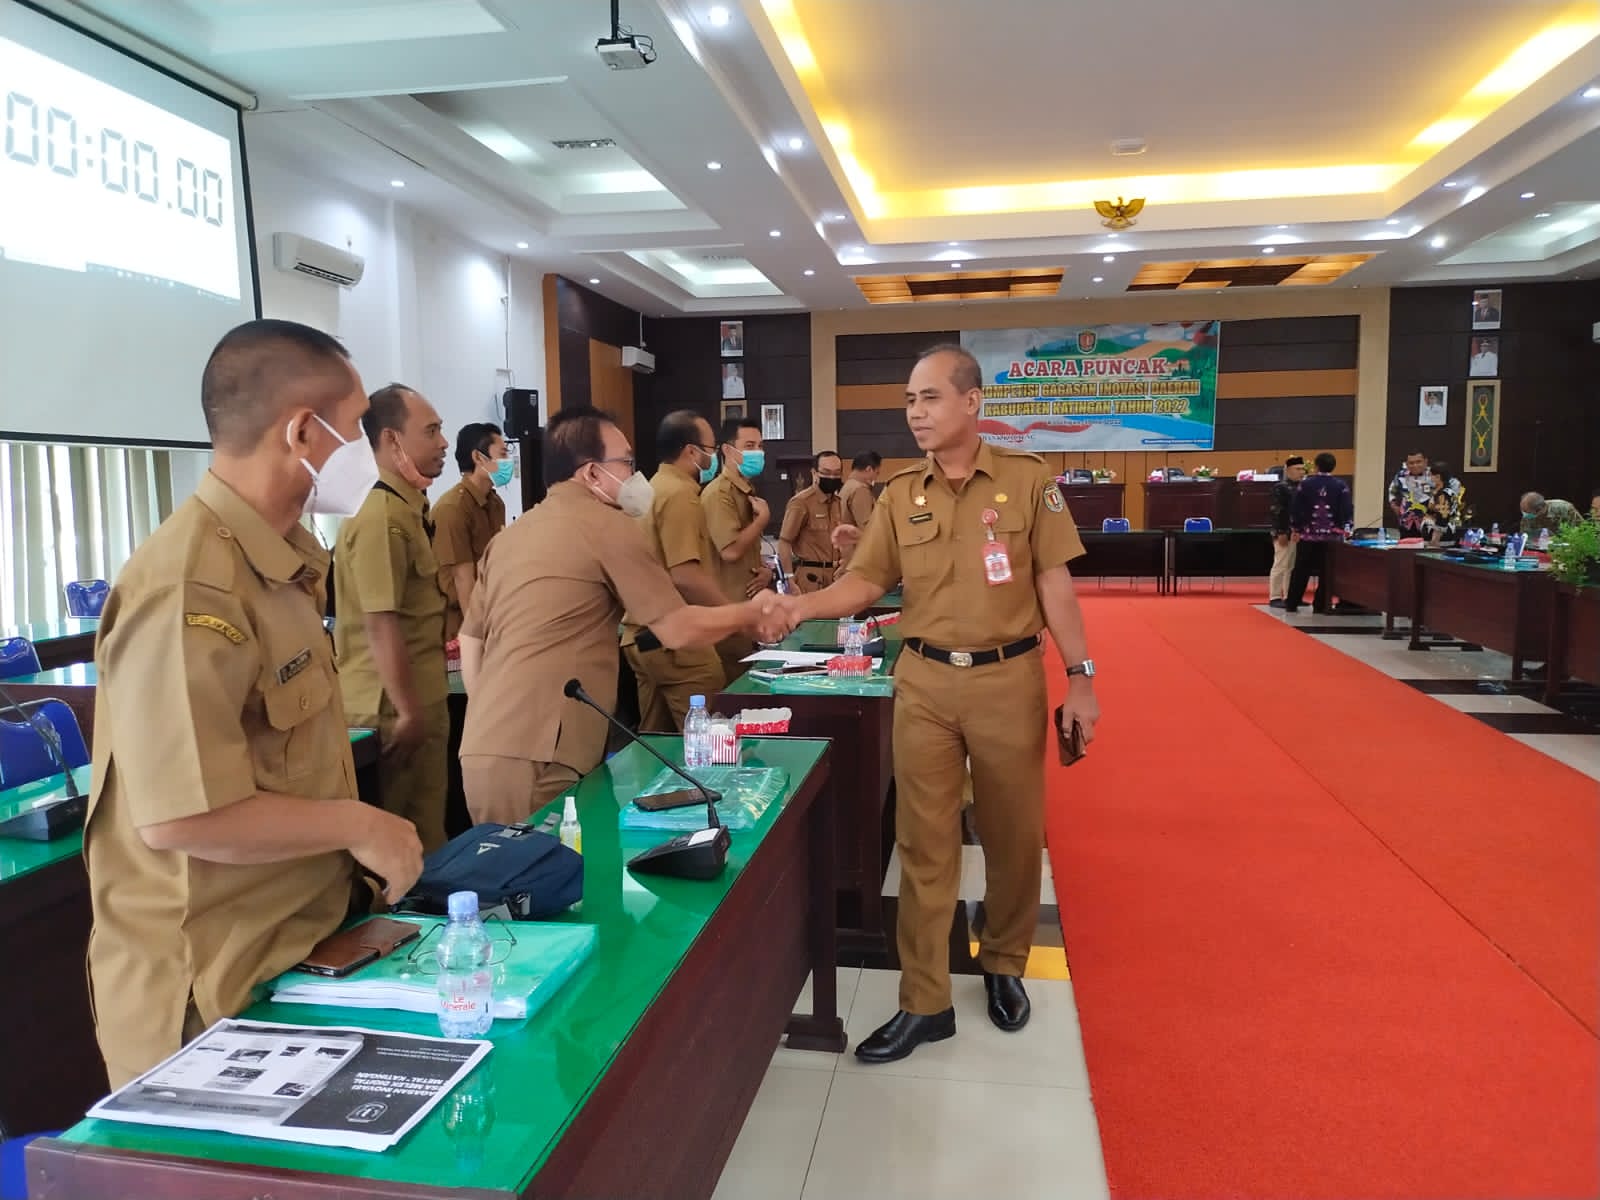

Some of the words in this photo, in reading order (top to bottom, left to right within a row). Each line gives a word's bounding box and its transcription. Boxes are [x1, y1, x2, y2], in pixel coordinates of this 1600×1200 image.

[1008, 359, 1081, 378] ACARA
[1083, 357, 1168, 377] PUNCAK
[982, 384, 1040, 398] OMPETISI
[1042, 382, 1097, 397] GAGASAN
[1100, 381, 1148, 396] INOVASI
[1151, 380, 1199, 396] DAERAH
[984, 402, 1050, 417] KABUPATEN
[1052, 400, 1111, 416] KATINGAN
[1114, 399, 1154, 414] TAHUN
[1156, 398, 1188, 413] 2022
